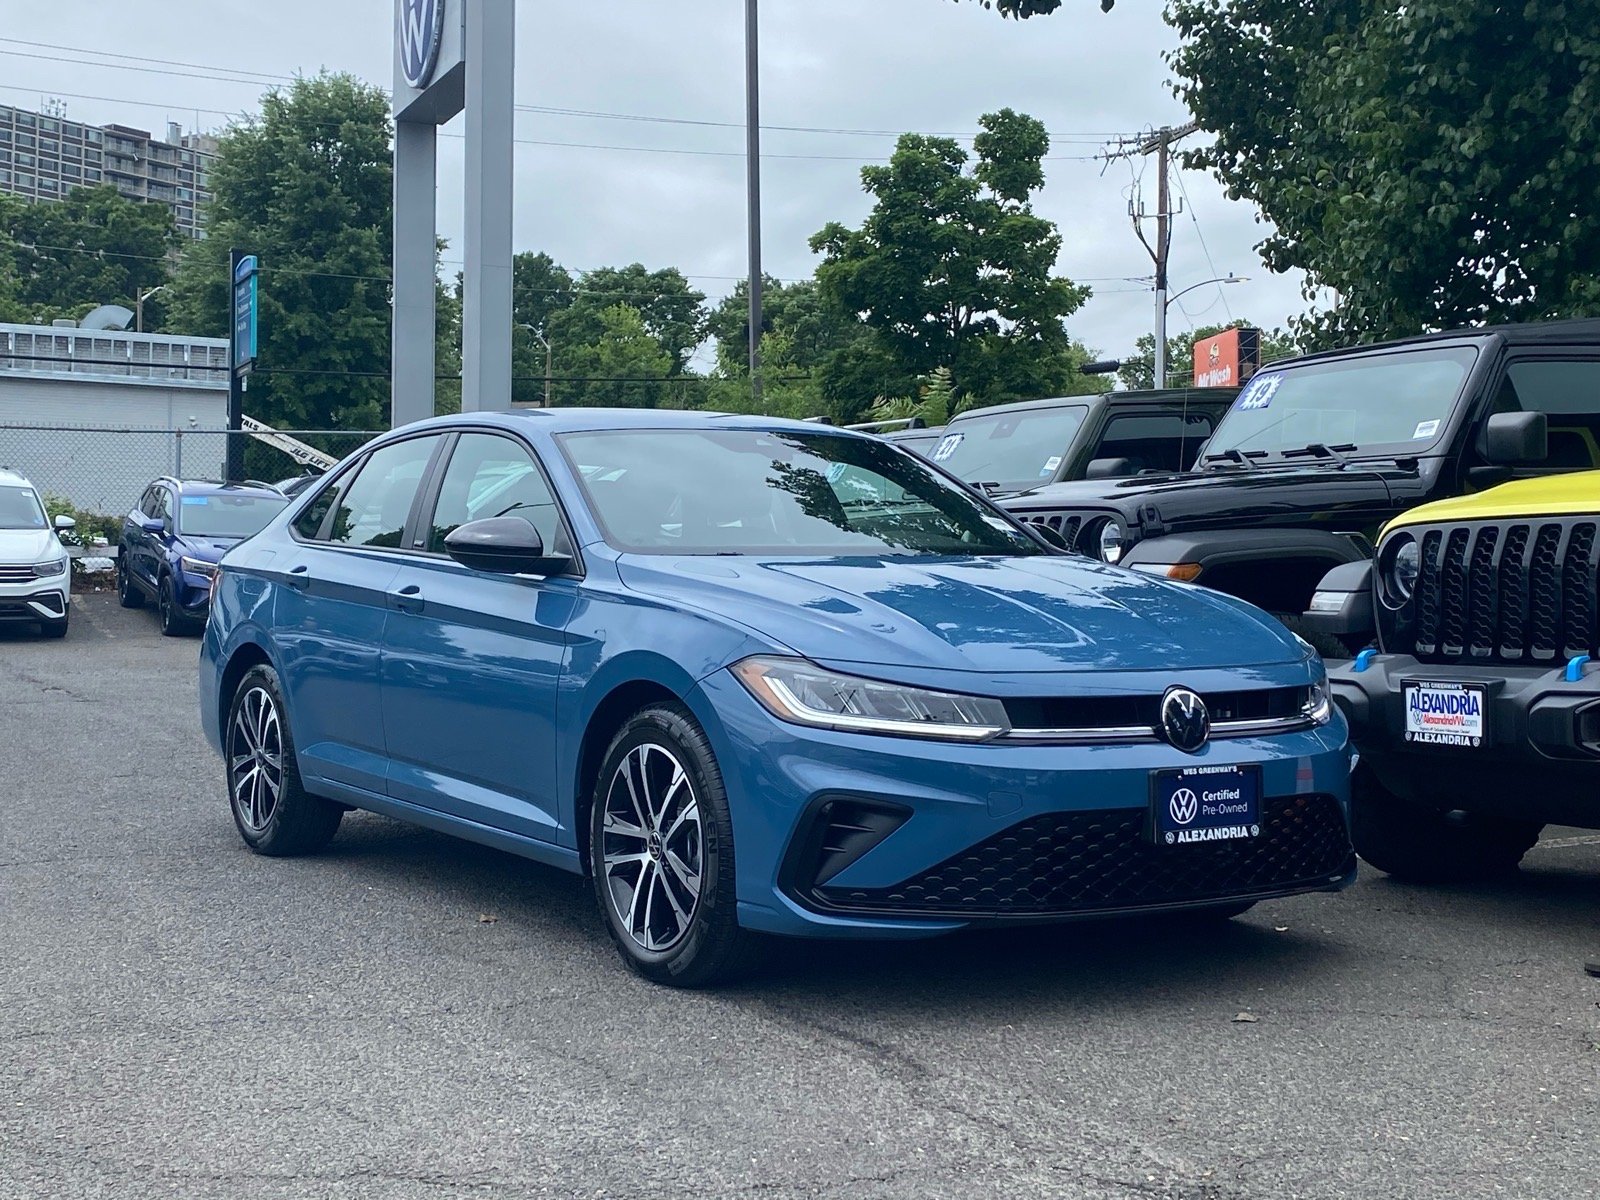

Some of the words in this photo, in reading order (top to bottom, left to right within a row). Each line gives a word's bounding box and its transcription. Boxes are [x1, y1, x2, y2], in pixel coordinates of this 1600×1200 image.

[1209, 364, 1231, 387] Wash
[1250, 382, 1272, 403] 19
[290, 448, 309, 459] JLG
[308, 456, 330, 469] LIFT
[1410, 692, 1480, 716] ALEXANDRIA
[1413, 732, 1471, 746] ALEXANDRIA
[1198, 765, 1238, 775] GREENWAY'S
[1202, 788, 1240, 801] Certified
[1169, 788, 1198, 824] VW
[1202, 802, 1248, 815] Pre-Owned
[1177, 826, 1249, 843] ALEXANDRIA
